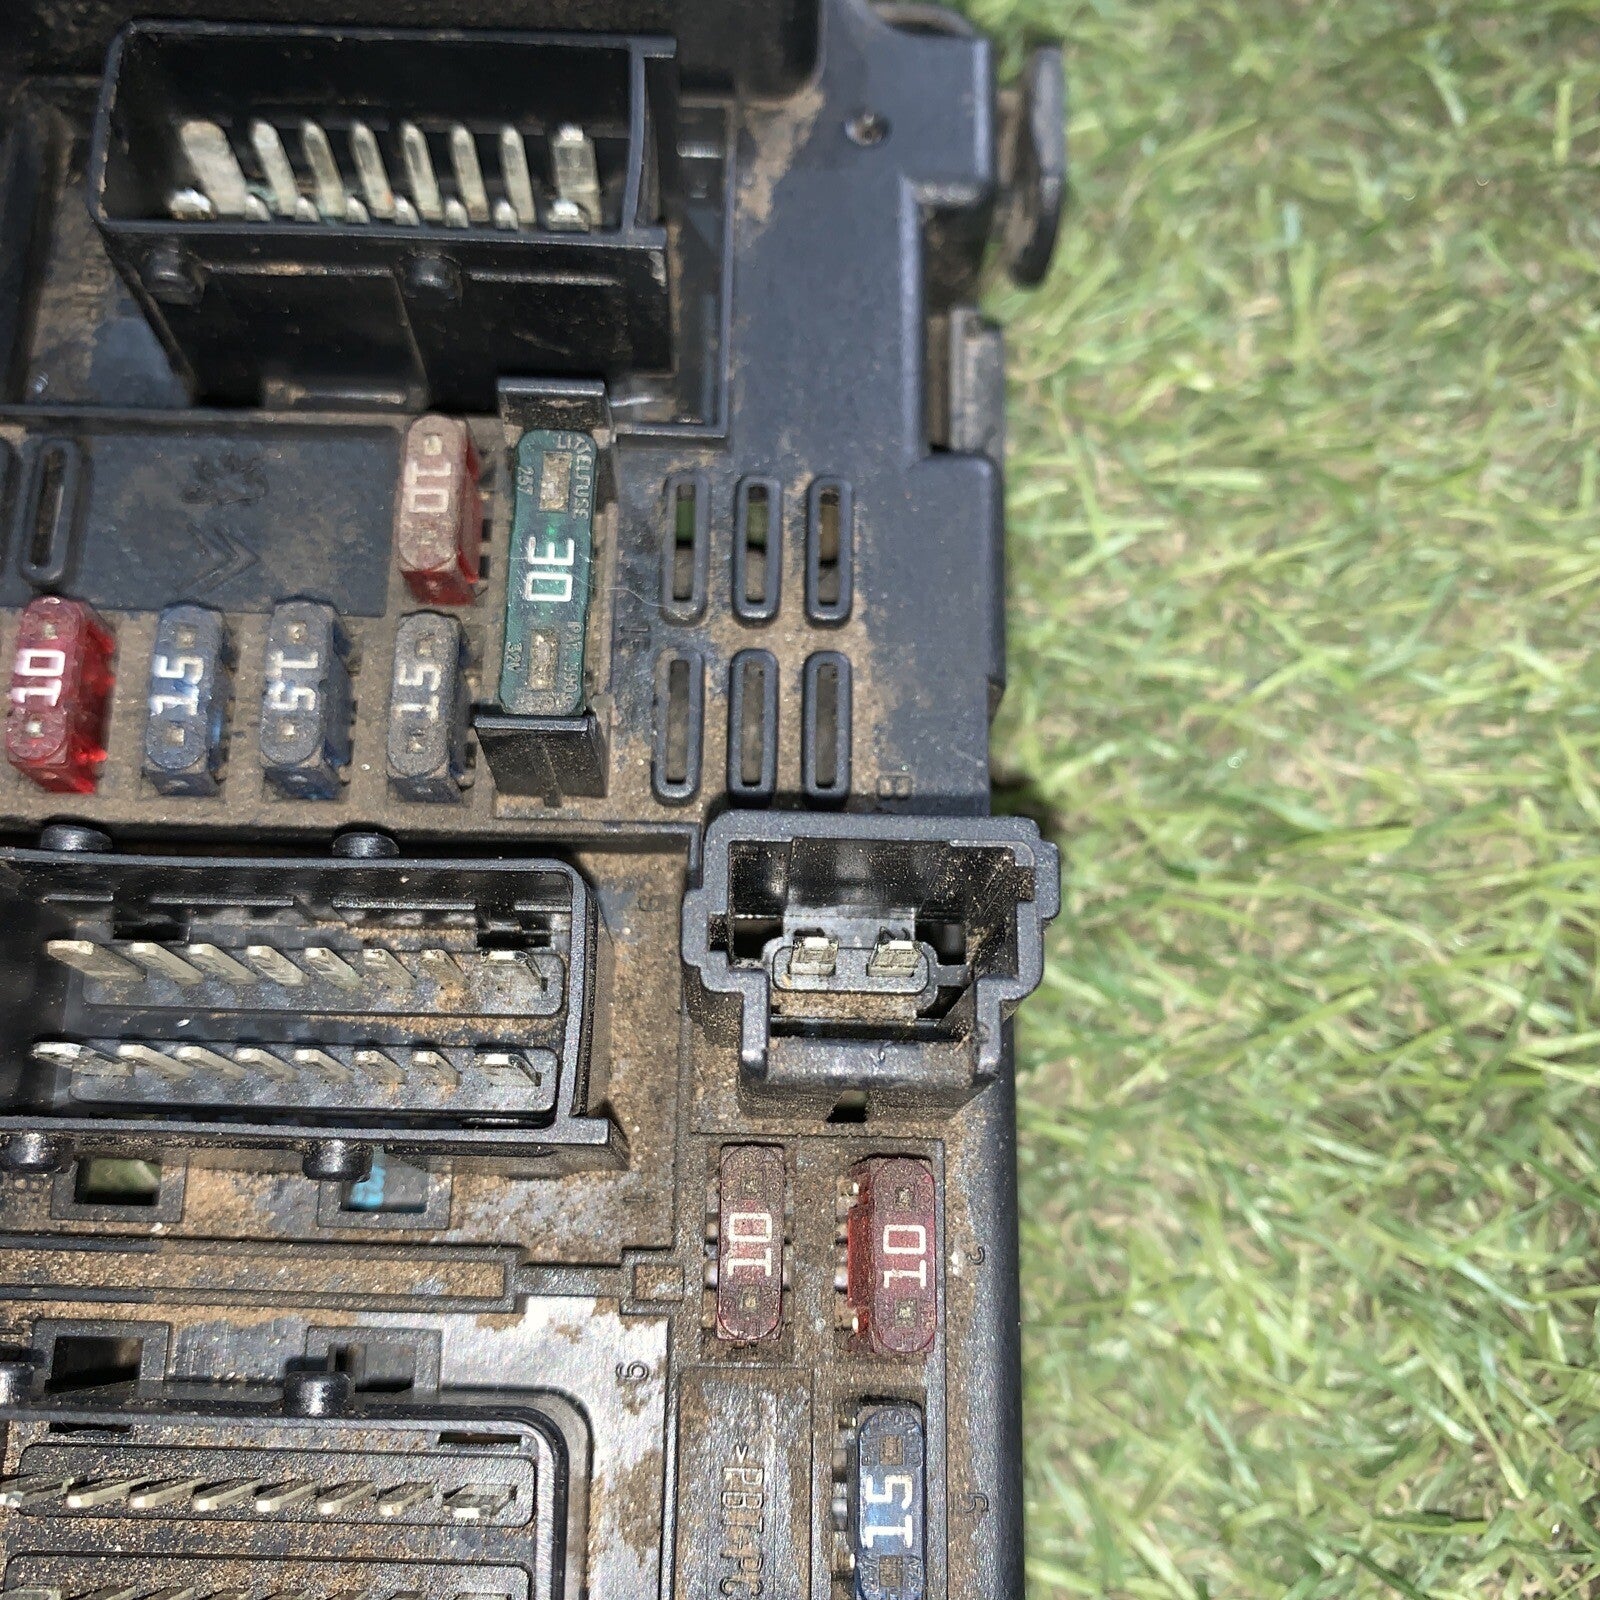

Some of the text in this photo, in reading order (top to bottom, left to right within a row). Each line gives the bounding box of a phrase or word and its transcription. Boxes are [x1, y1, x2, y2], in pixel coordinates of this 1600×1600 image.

[404, 460, 451, 513] 10
[525, 536, 575, 602] 30
[9, 648, 66, 707] 10
[149, 654, 204, 717] 15
[265, 649, 319, 712] 15
[391, 662, 442, 723] 15
[727, 1212, 773, 1278] 10
[882, 1224, 927, 1290] 10
[863, 1474, 914, 1549] 15
